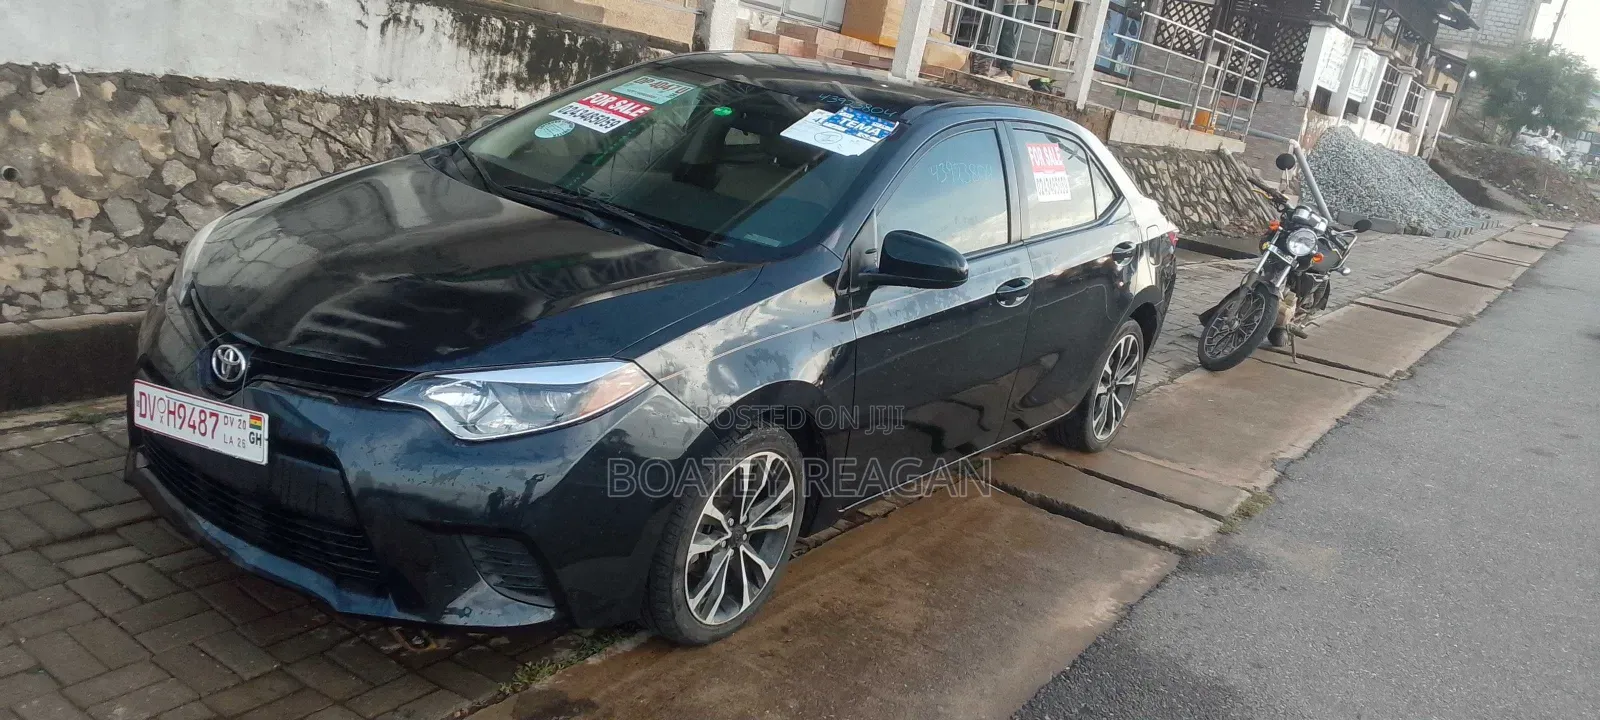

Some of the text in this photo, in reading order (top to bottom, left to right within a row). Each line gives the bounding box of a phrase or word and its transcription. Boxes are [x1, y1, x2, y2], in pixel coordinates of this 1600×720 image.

[583, 91, 618, 107] FOR
[608, 98, 651, 118] SALE
[839, 117, 882, 137] TEMA
[1027, 145, 1064, 167] FOR SALE
[139, 391, 157, 421] DV
[167, 399, 220, 440] H9487
[223, 415, 235, 428] DV
[237, 418, 247, 430] 20
[223, 433, 234, 446] LA
[248, 431, 262, 447] GH
